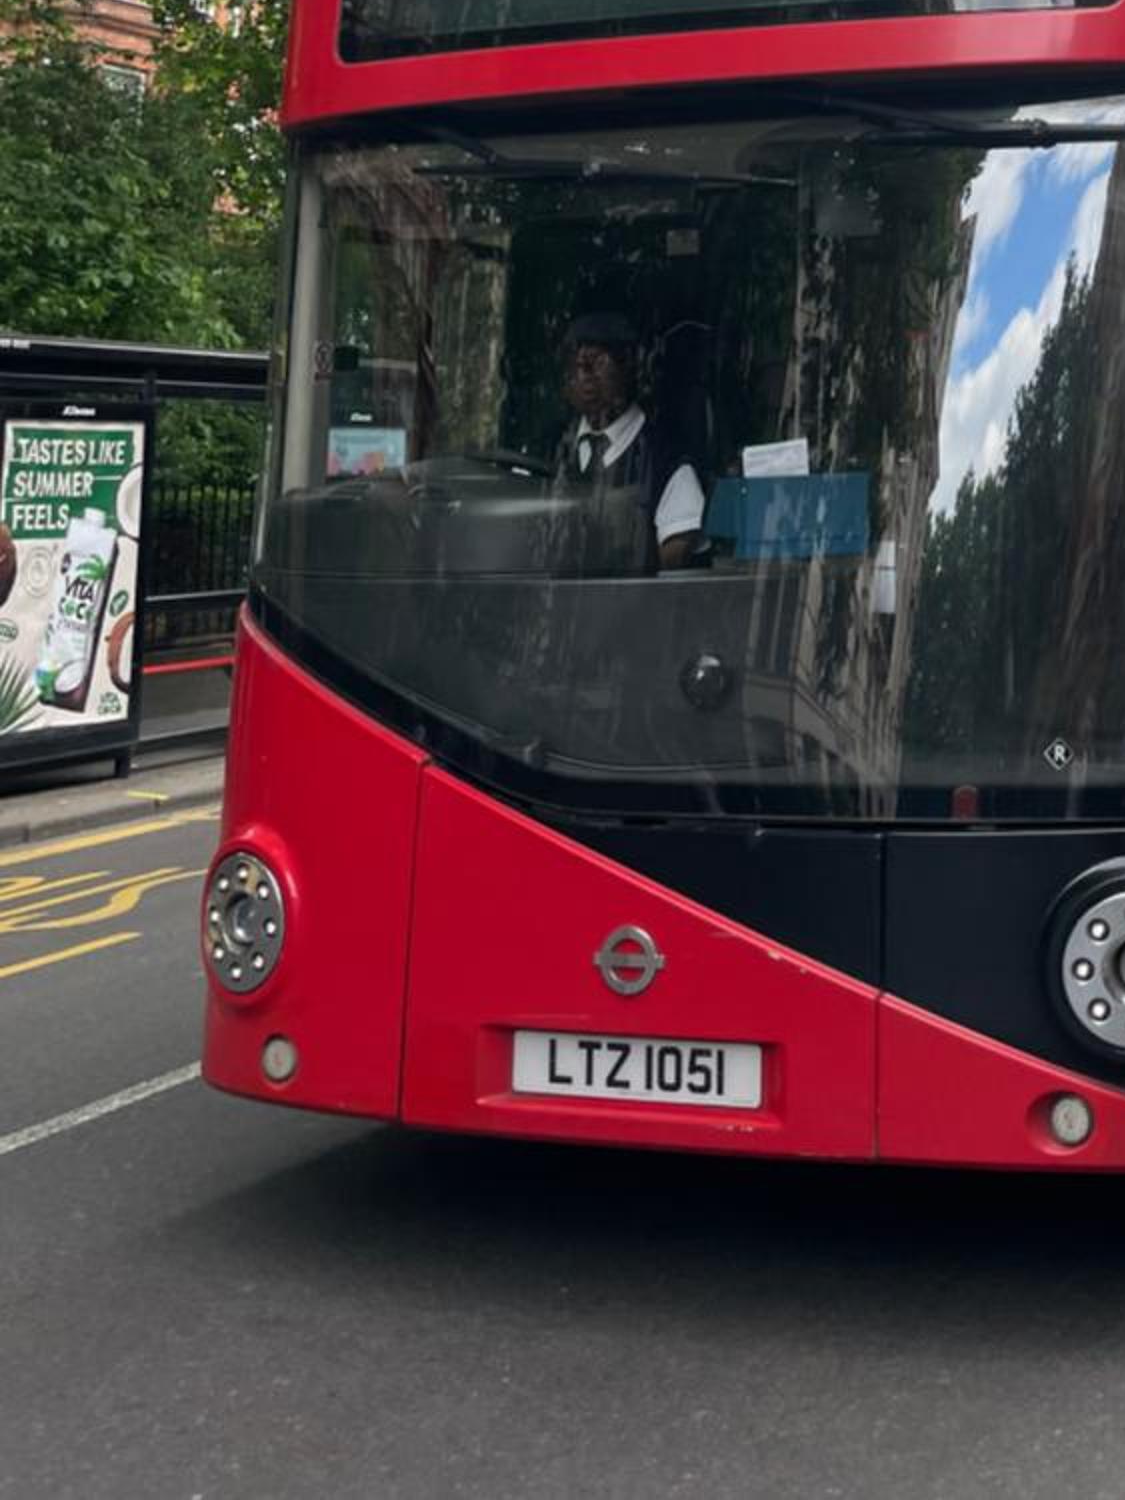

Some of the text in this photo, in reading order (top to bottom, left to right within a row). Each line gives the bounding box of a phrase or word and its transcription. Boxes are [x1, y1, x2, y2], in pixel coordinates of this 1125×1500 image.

[18, 437, 127, 466] TASTES LIKE
[12, 470, 94, 498] SUMMER
[11, 503, 71, 531] FEELS
[548, 1038, 726, 1096] LTZ 1051
